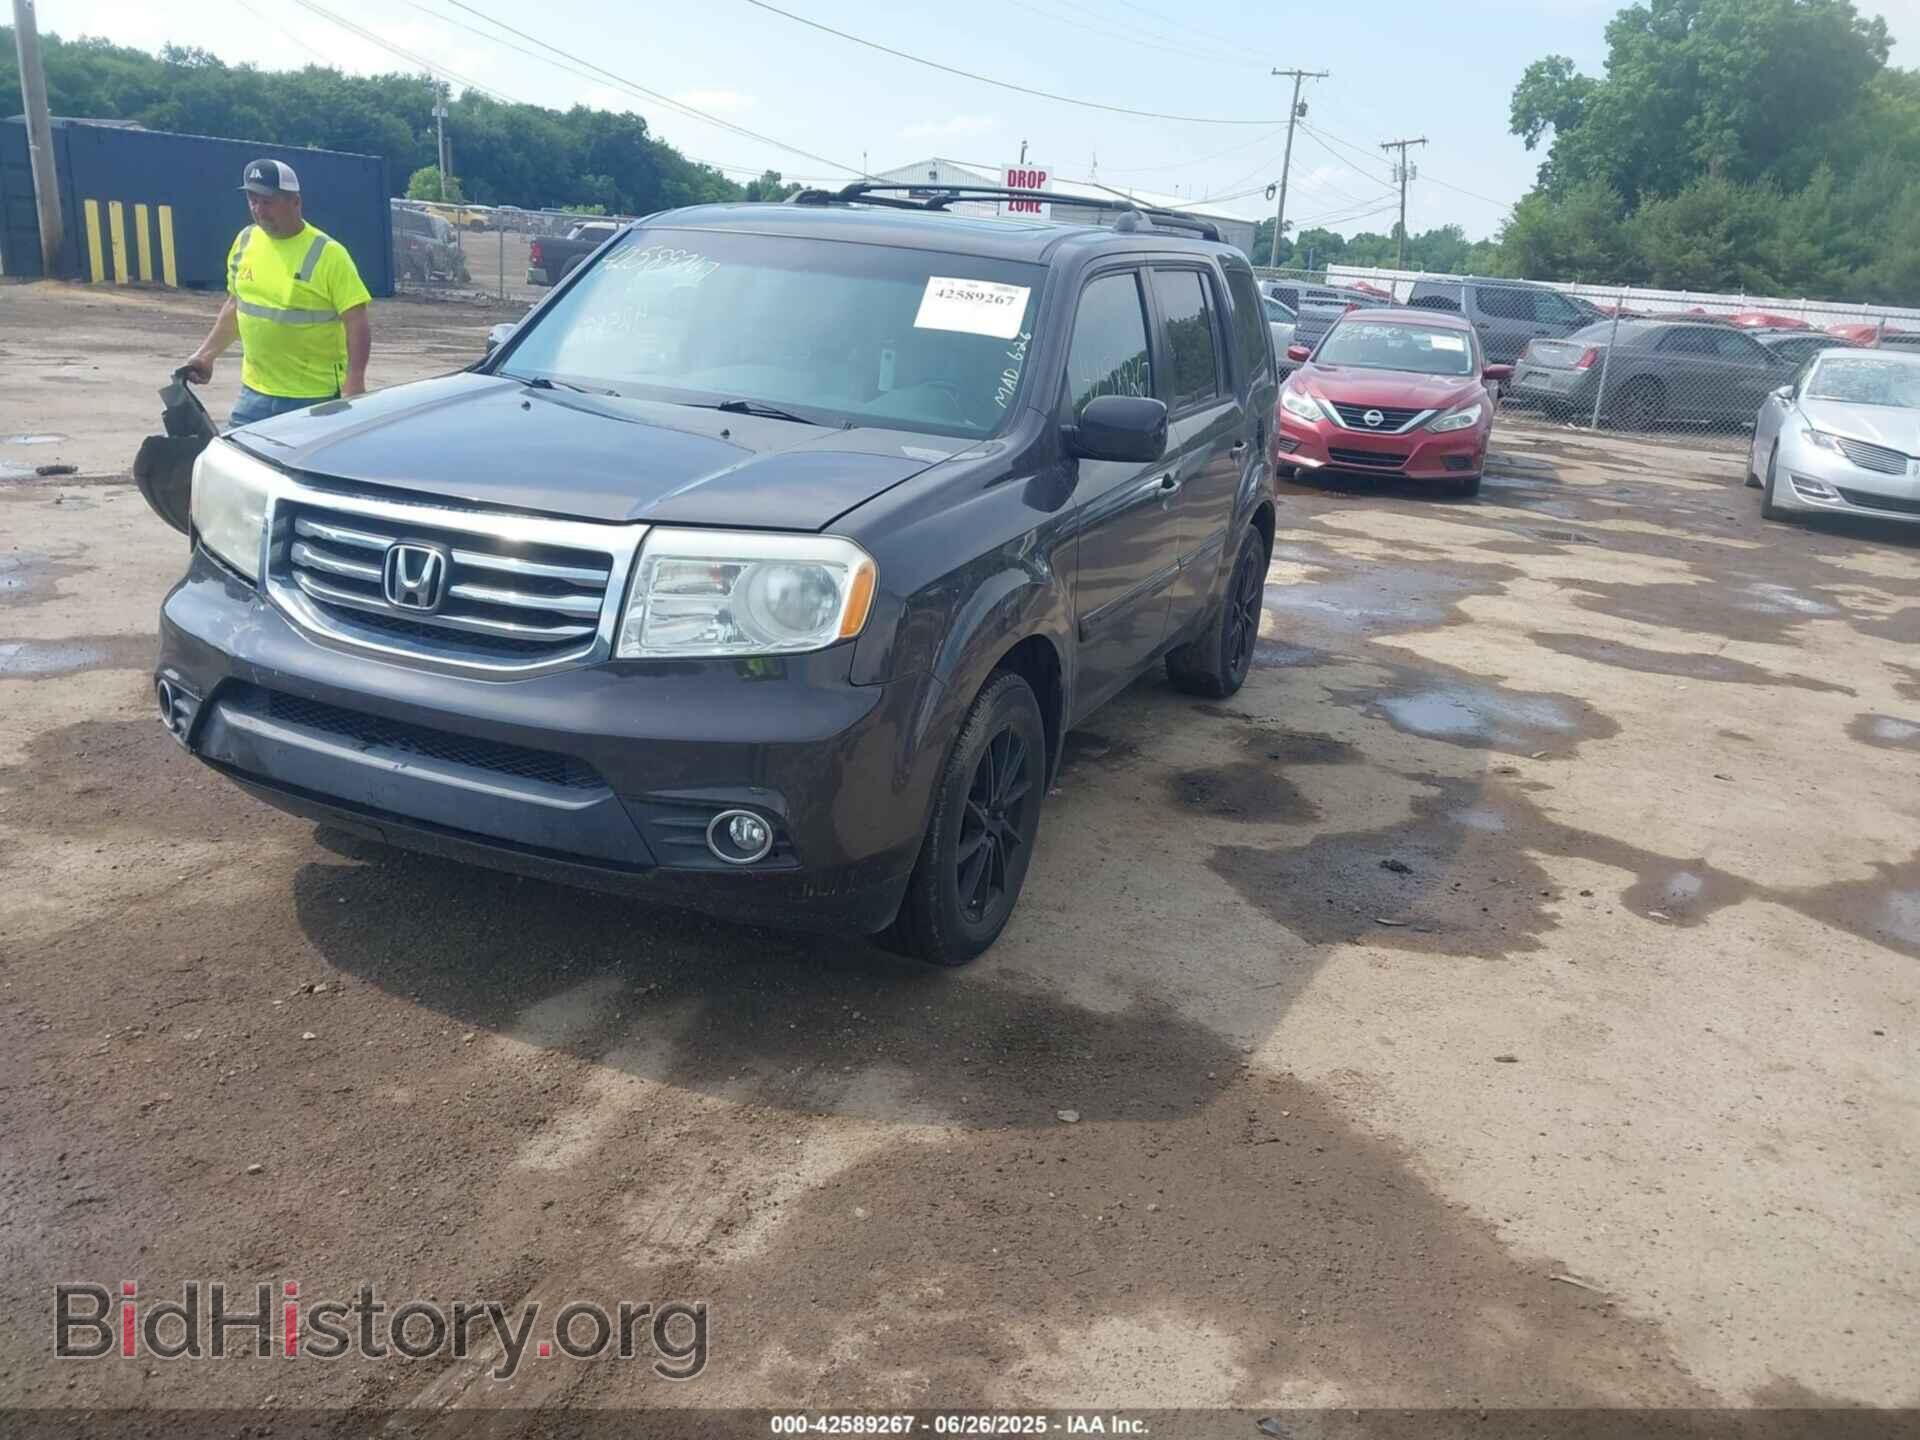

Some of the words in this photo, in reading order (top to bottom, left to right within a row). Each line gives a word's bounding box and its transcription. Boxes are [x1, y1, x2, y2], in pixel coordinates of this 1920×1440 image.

[1007, 169, 1046, 189] DROP
[1008, 192, 1042, 213] ZONE
[935, 288, 1016, 307] 42589267
[994, 367, 1020, 409] MAD
